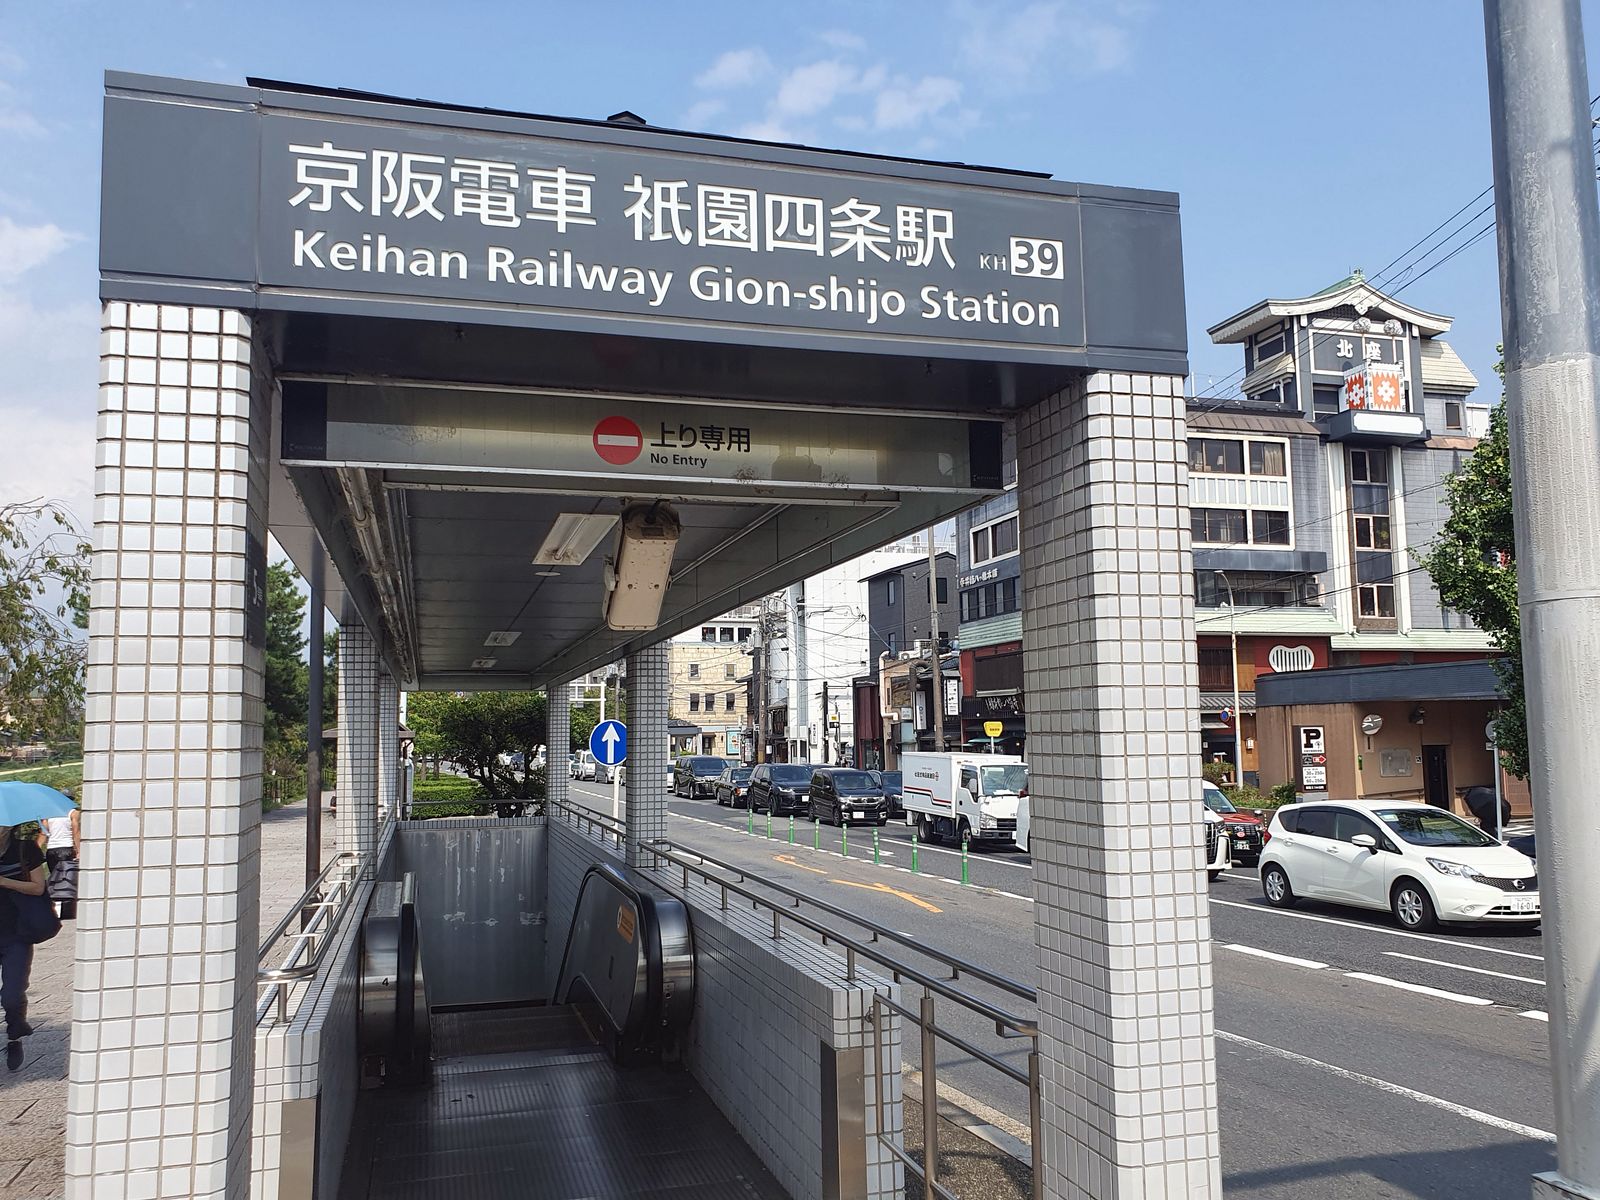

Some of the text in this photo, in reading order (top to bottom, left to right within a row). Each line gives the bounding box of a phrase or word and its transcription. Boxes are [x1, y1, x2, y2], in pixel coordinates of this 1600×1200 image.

[288, 142, 956, 270] 京阪電車 祇園四条駅
[979, 240, 1059, 276] KH 39
[294, 229, 1060, 328] Keihan Railway Gion-shijo Station
[650, 421, 751, 453] 上り専用
[650, 453, 708, 469] No Entry
[1303, 728, 1321, 748] P
